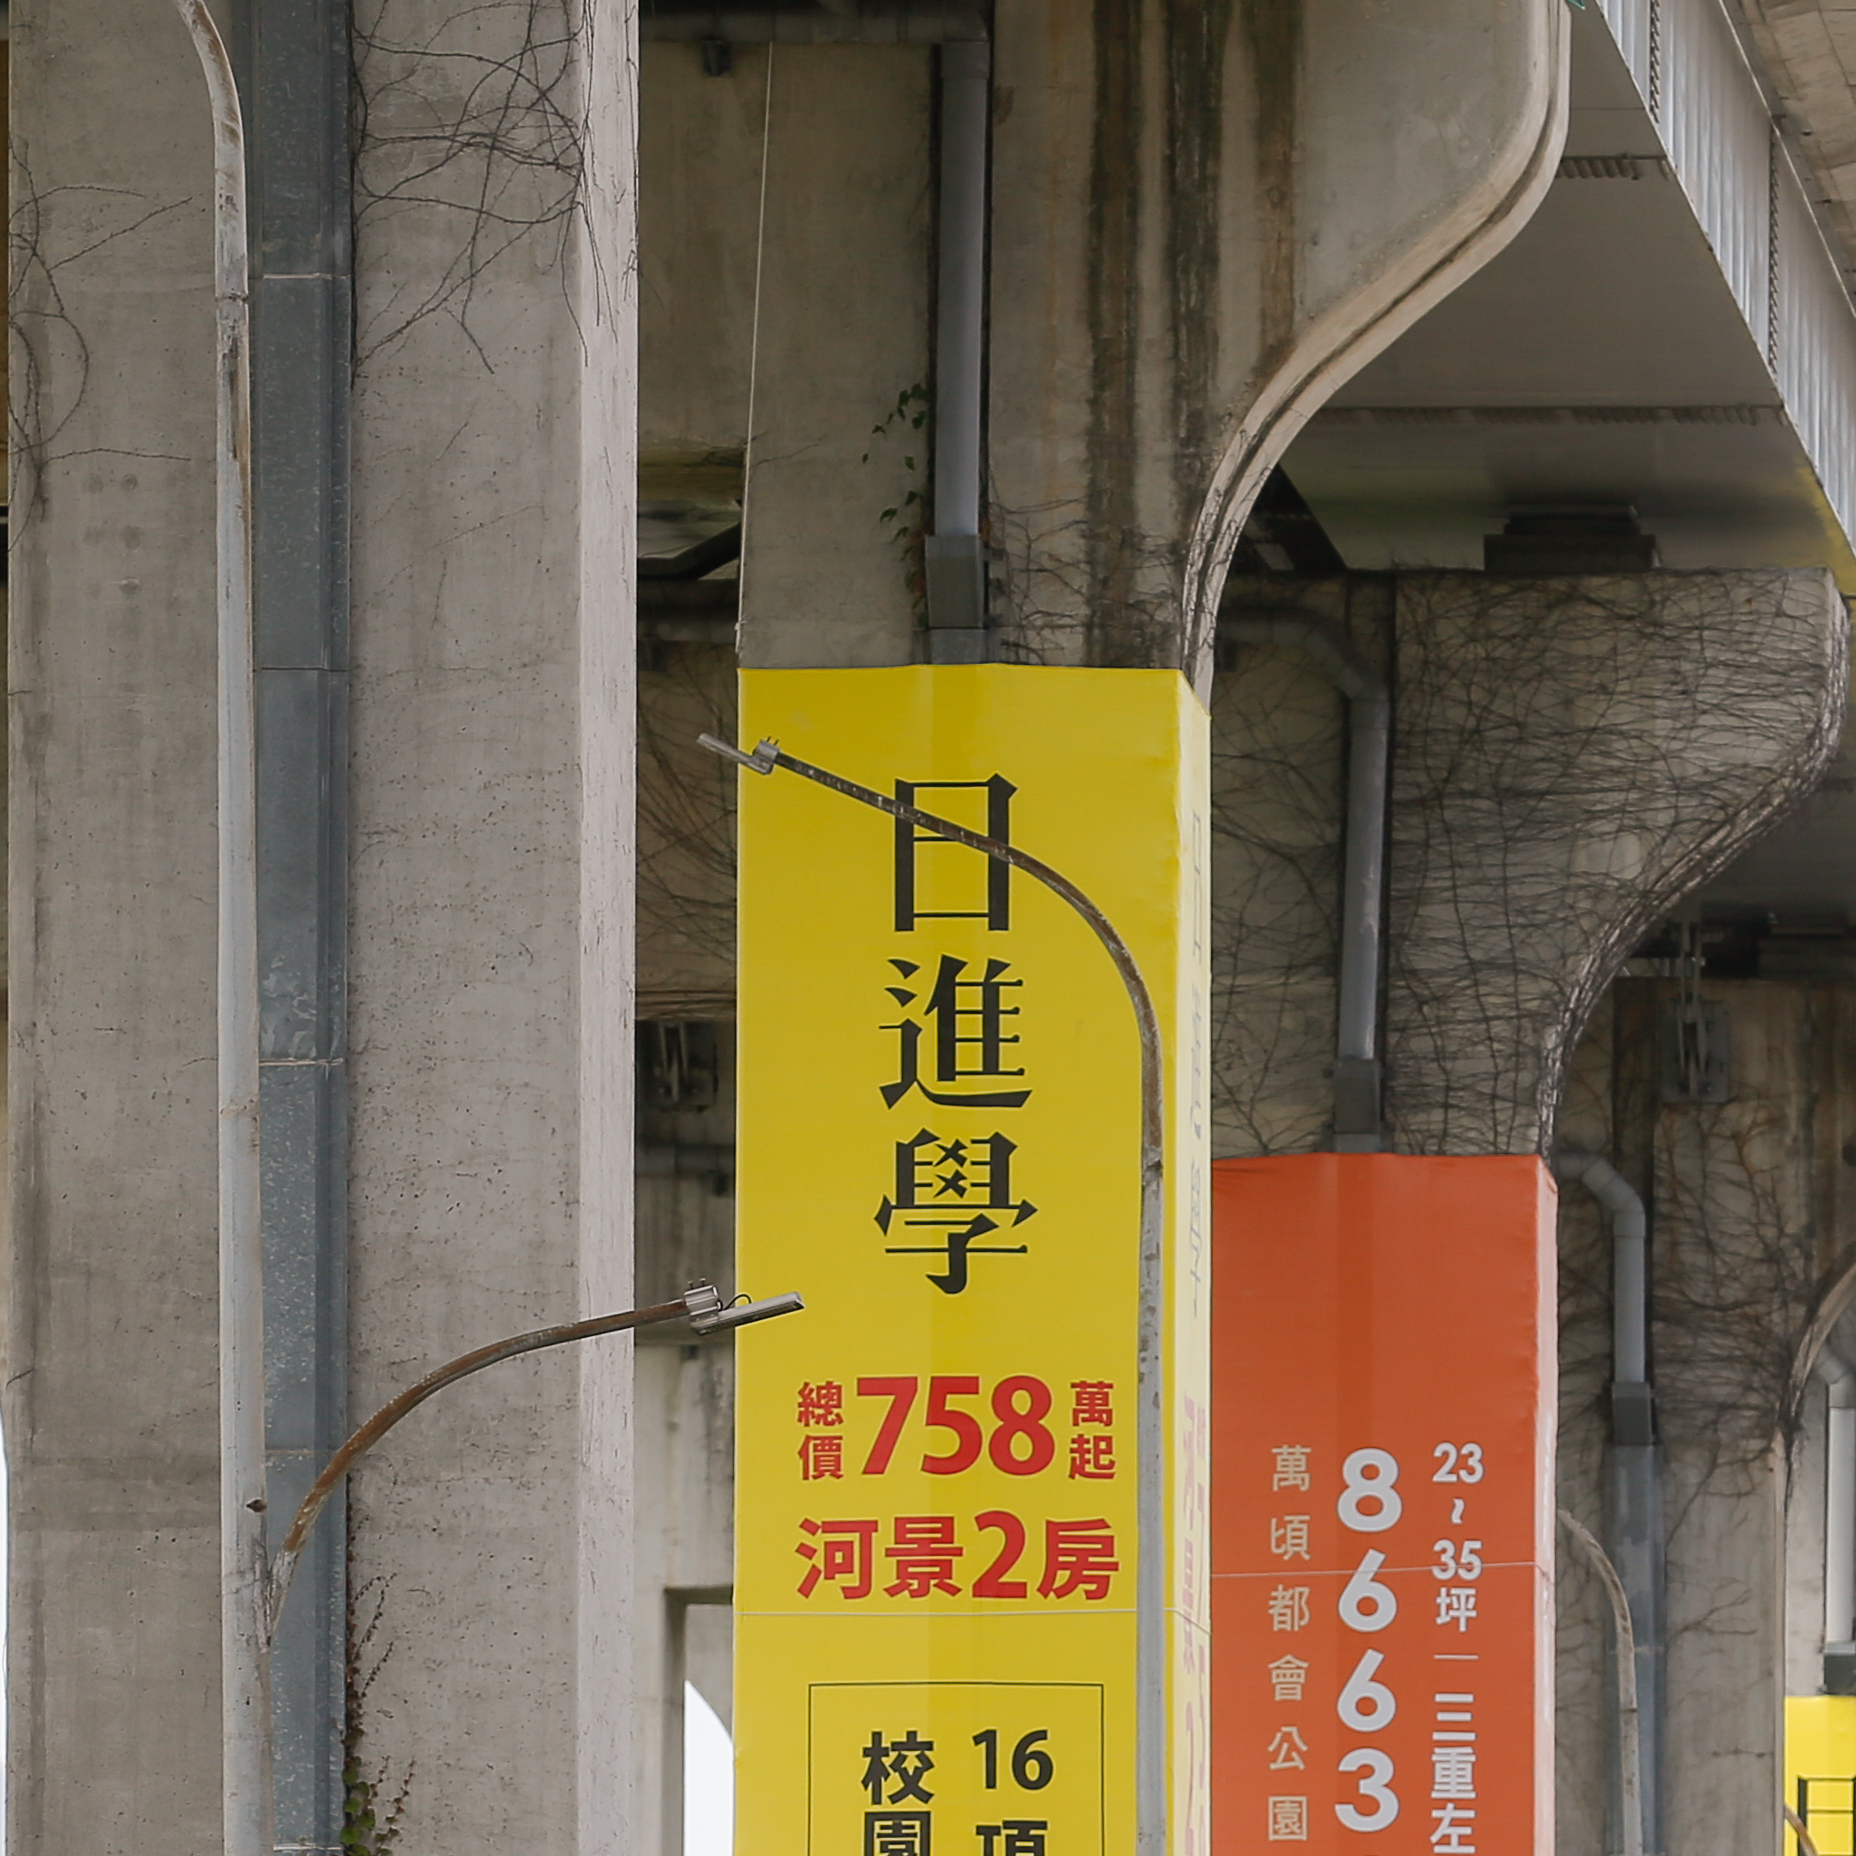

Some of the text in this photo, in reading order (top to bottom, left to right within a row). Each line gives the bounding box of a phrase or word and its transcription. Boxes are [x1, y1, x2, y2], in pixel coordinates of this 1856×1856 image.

[874, 773, 1038, 1295] 日進學
[797, 1381, 844, 1480] 總價
[856, 1375, 1055, 1476] 758
[1068, 1381, 1116, 1480] 萬起
[795, 1510, 1120, 1600] 河景2房
[1268, 1445, 1311, 1841] 萬頃都會公園
